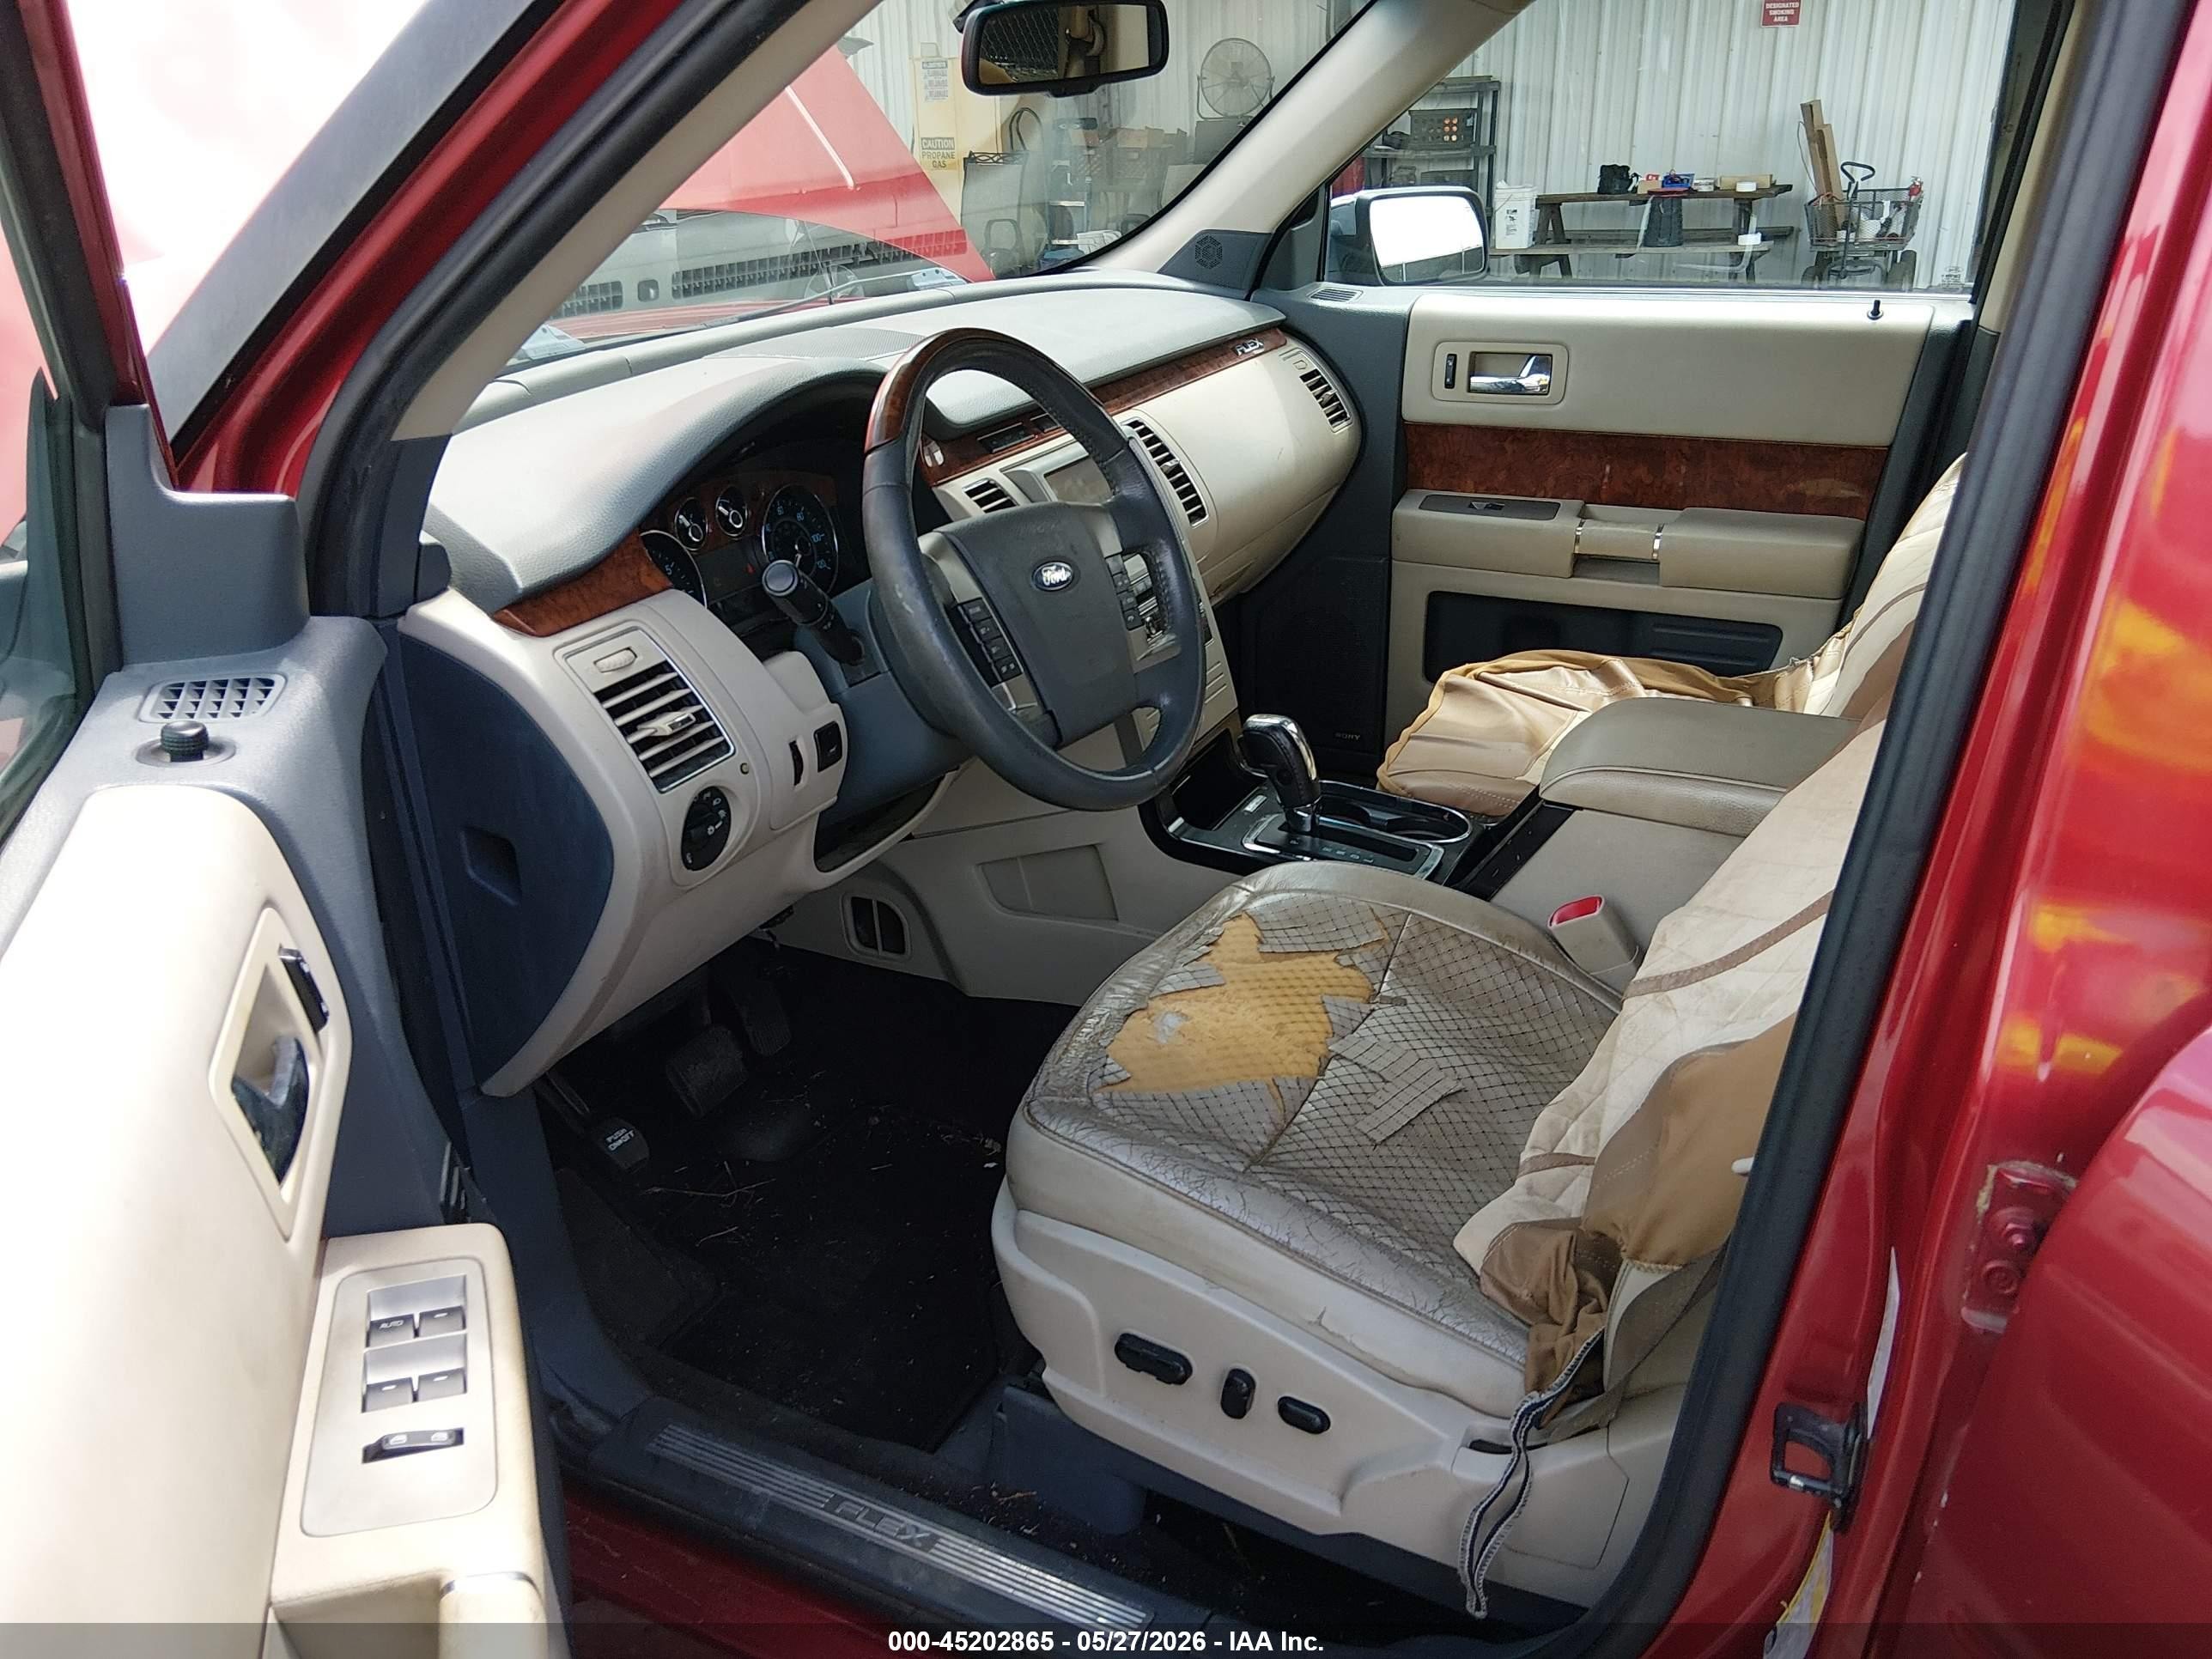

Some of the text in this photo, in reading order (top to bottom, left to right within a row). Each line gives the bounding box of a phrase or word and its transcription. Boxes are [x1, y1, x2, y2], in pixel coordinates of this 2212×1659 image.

[922, 138, 954, 149] CAUTION
[664, 564, 673, 576] 5
[1041, 564, 1073, 586] Ford
[379, 1320, 404, 1329] AUTO
[834, 1500, 932, 1547] FLEX
